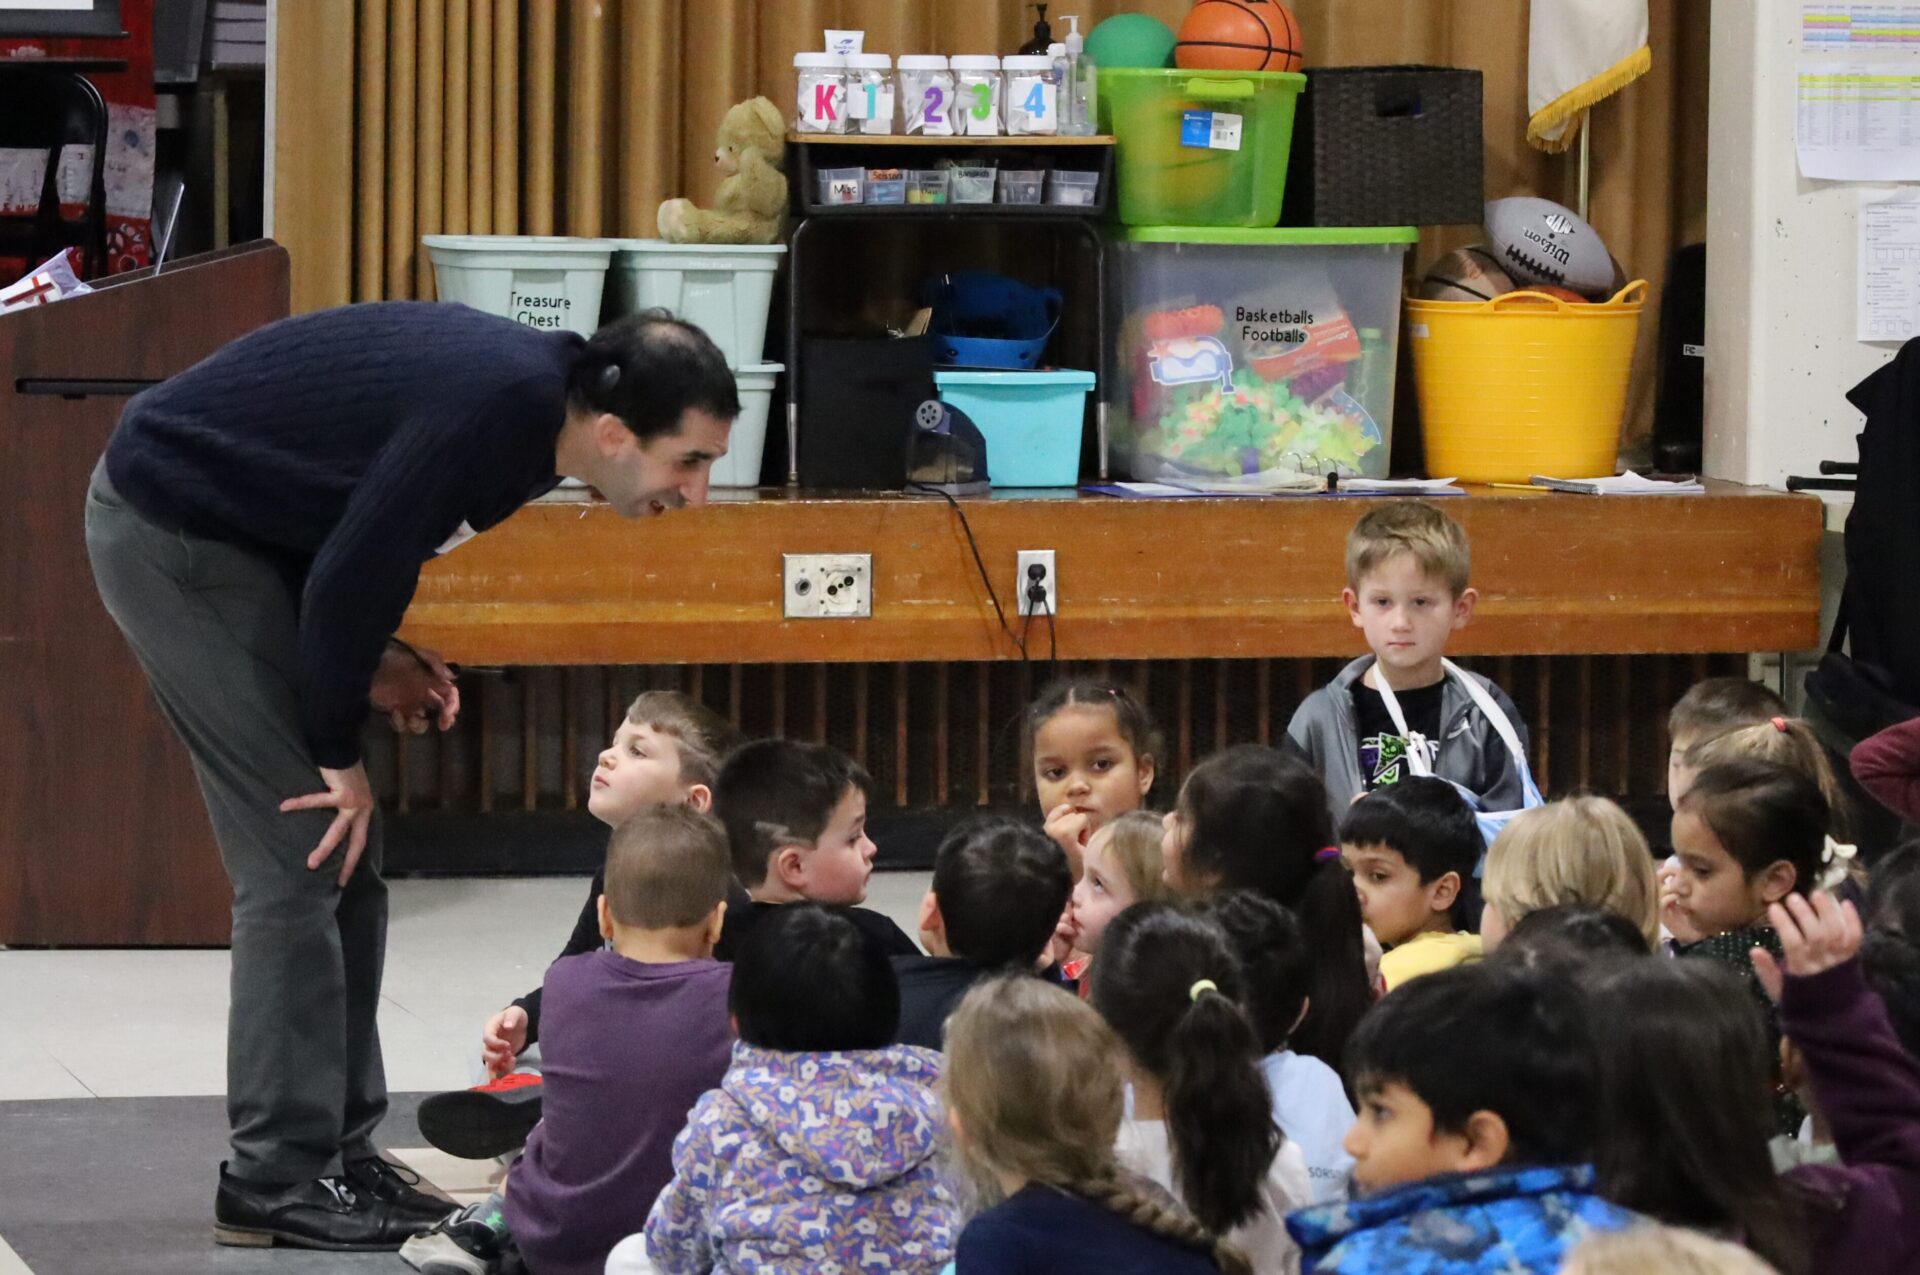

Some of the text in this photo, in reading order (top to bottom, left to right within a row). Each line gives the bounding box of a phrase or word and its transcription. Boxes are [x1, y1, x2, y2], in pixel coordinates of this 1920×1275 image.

[815, 84, 837, 121] K
[864, 83, 876, 120] 1
[923, 86, 944, 123] 2
[971, 83, 991, 120] 3
[1024, 82, 1046, 119] 4
[833, 184, 857, 195] Misc
[1523, 229, 1570, 266] Wilson
[510, 291, 571, 310] Treasure
[516, 311, 561, 327] Chest
[1236, 306, 1314, 325] Basketballs
[1242, 325, 1306, 343] Footballs
